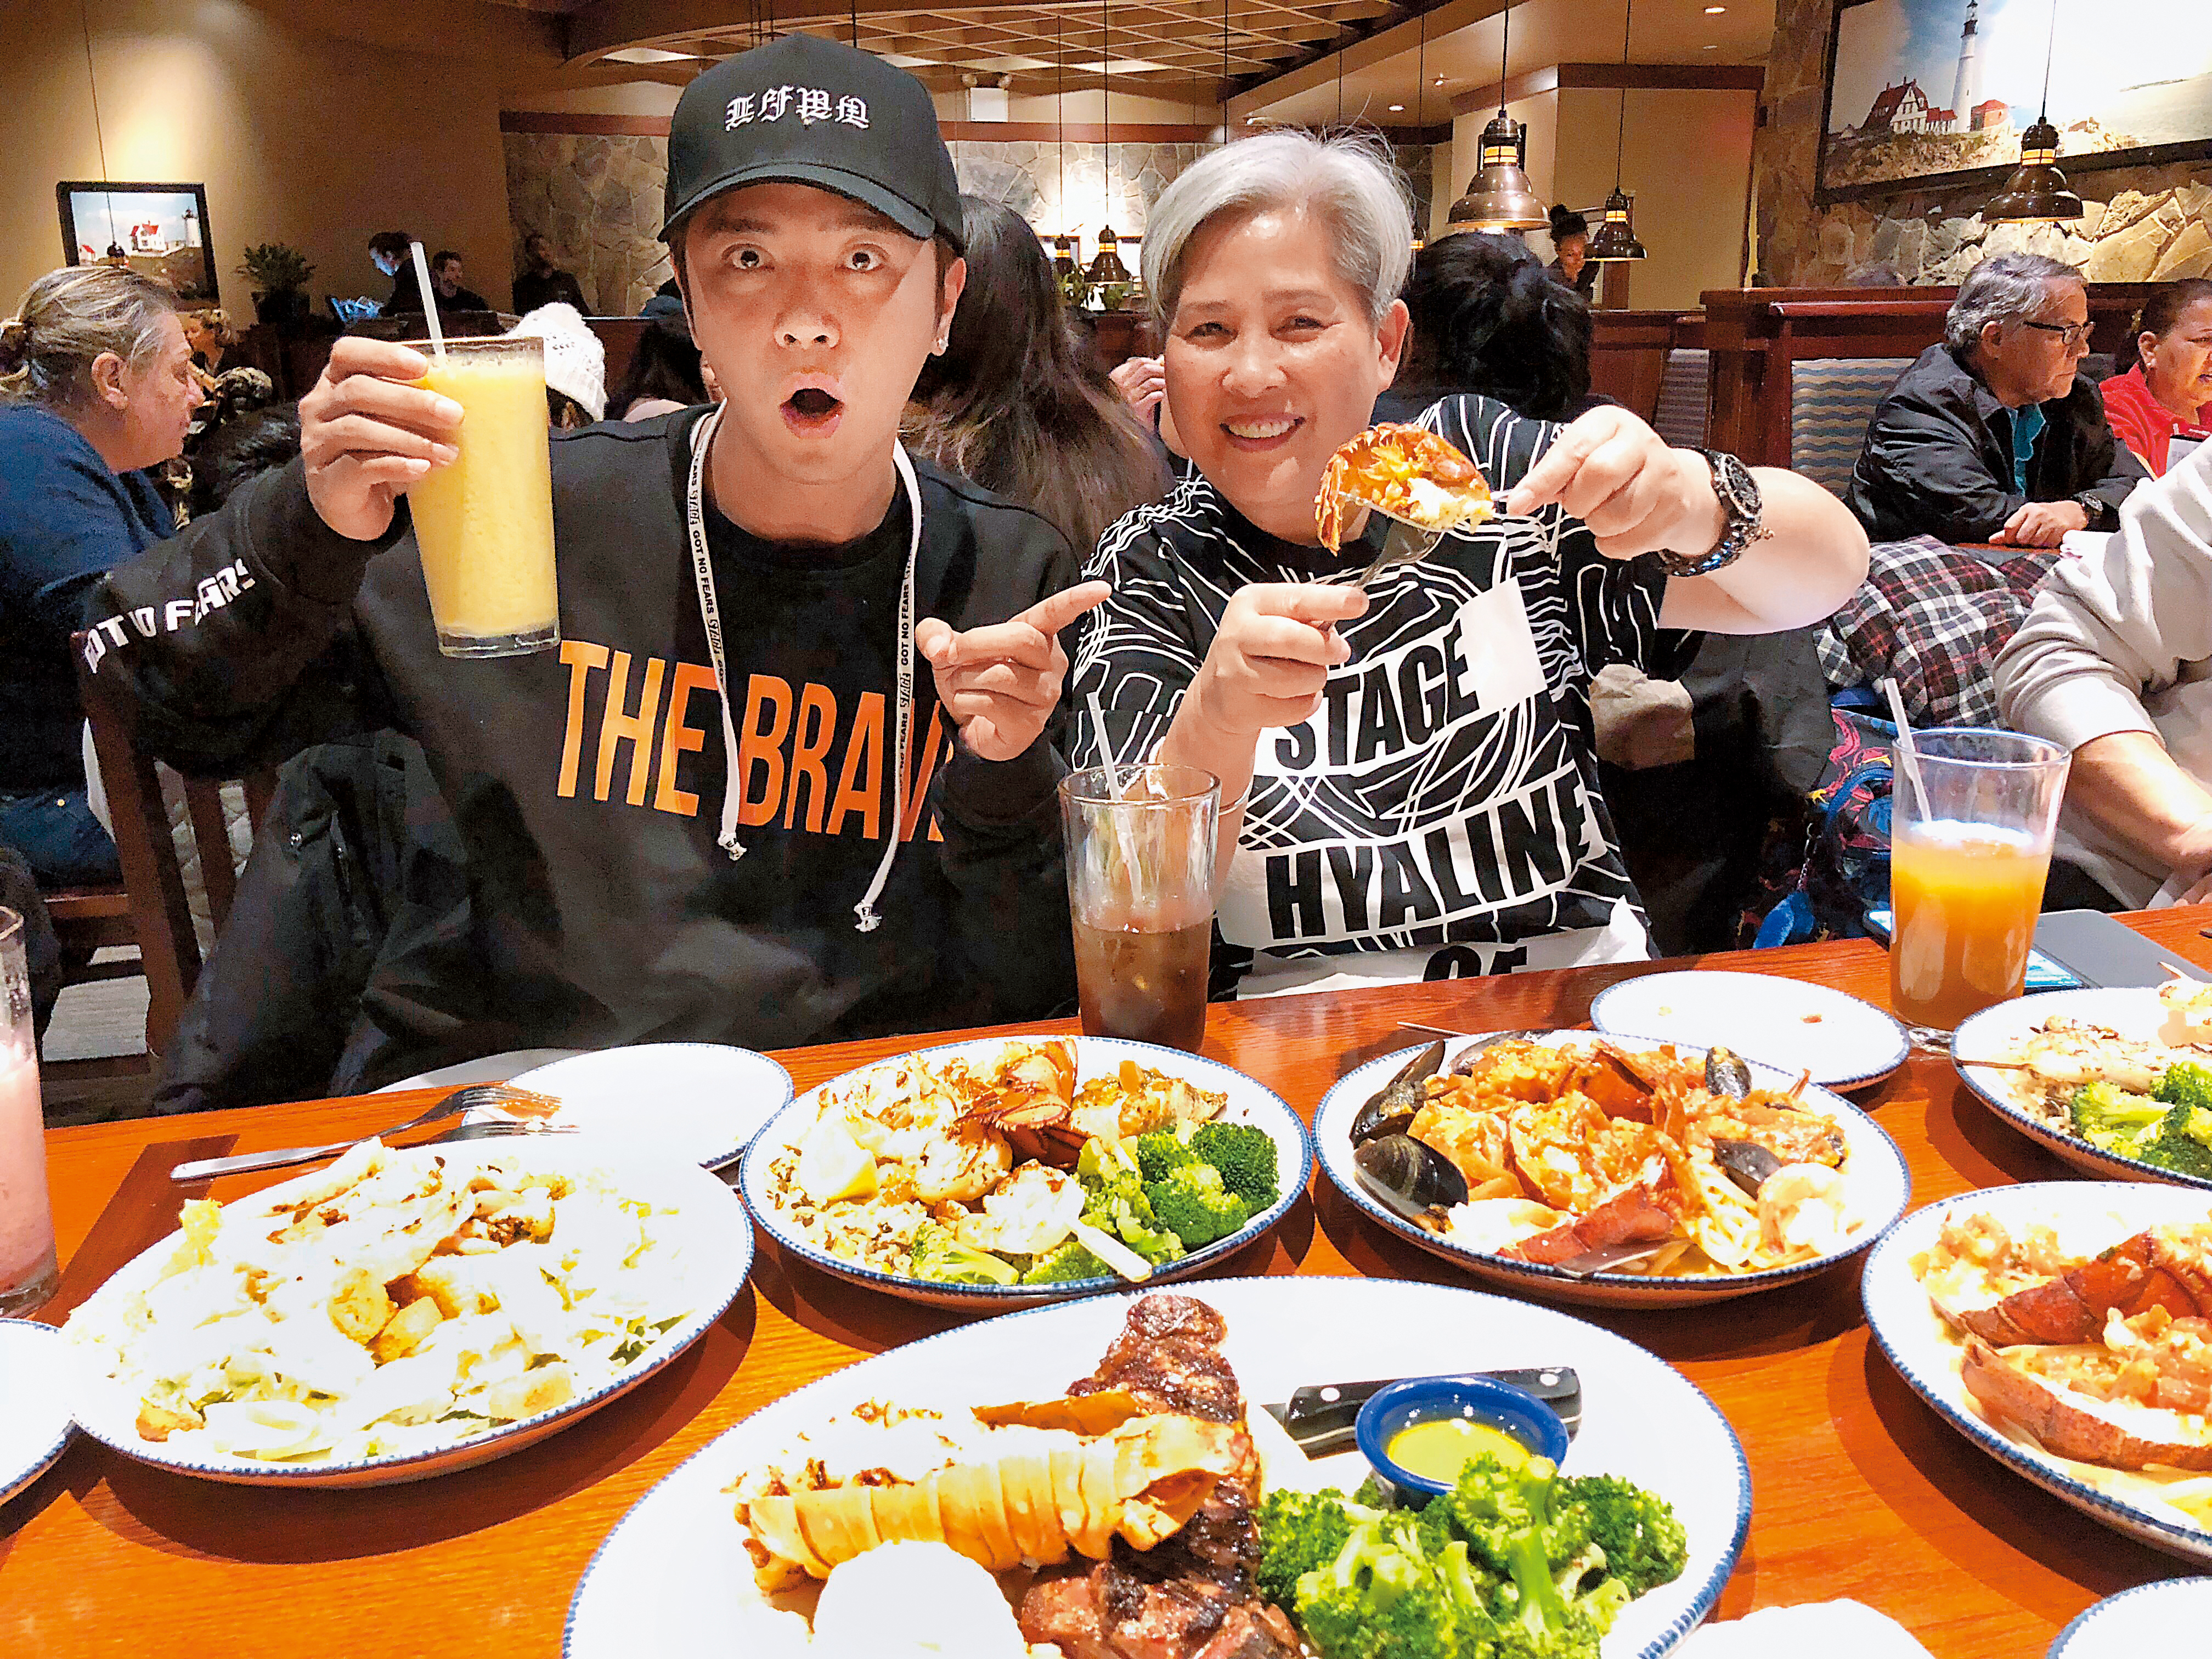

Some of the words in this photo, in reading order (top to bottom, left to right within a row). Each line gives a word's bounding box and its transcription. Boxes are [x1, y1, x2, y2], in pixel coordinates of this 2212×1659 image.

[693, 530, 703, 554] GOT
[698, 557, 707, 574] NO
[701, 577, 714, 614] FEARS
[901, 584, 910, 619] FEARS
[84, 614, 129, 674] OT
[901, 622, 910, 639] NO
[901, 641, 910, 666] GOT
[899, 673, 911, 708] STAGE
[557, 640, 718, 817] THE
[738, 674, 954, 842] BRAV
[1266, 768, 1590, 940] HYALINE
